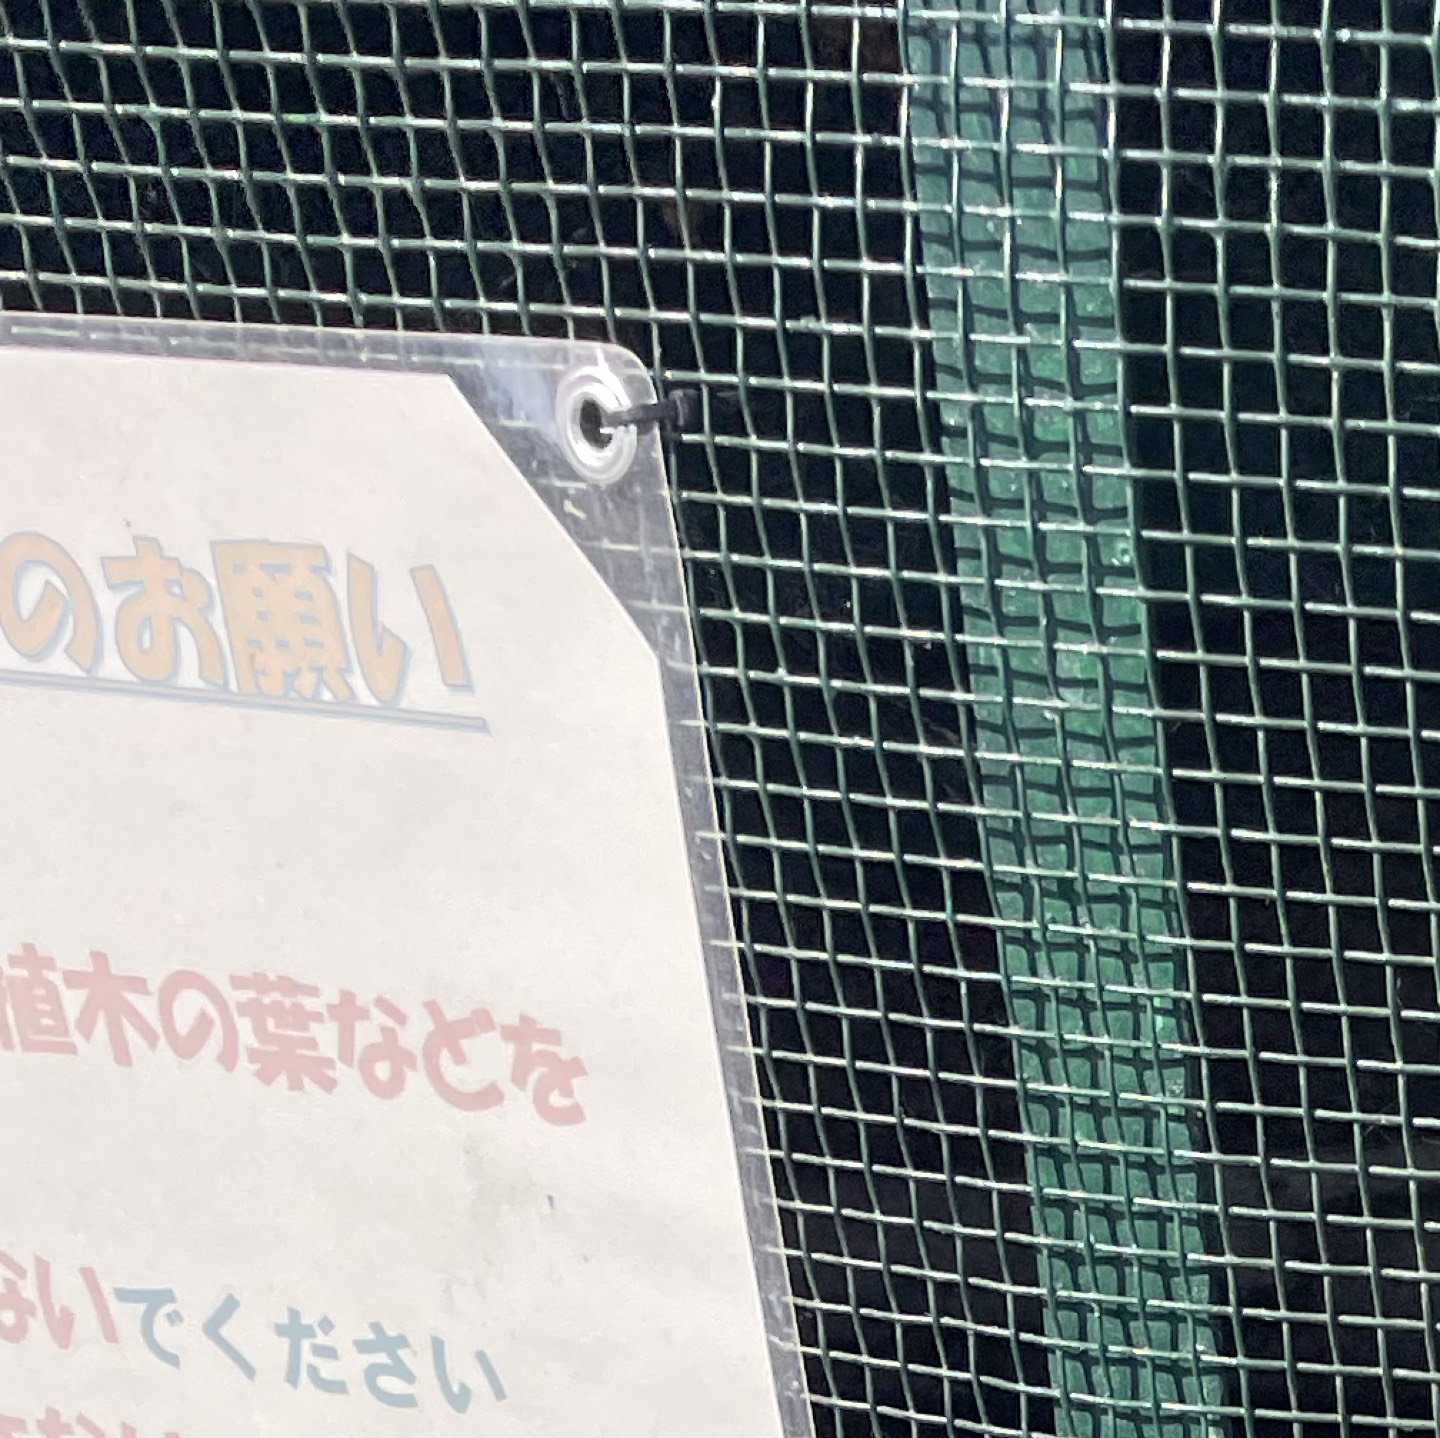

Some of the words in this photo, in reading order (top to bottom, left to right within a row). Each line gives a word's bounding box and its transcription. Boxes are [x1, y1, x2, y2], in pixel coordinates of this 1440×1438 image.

[0, 531, 475, 707] のお願い
[0, 942, 588, 1125] 植木の葉などを
